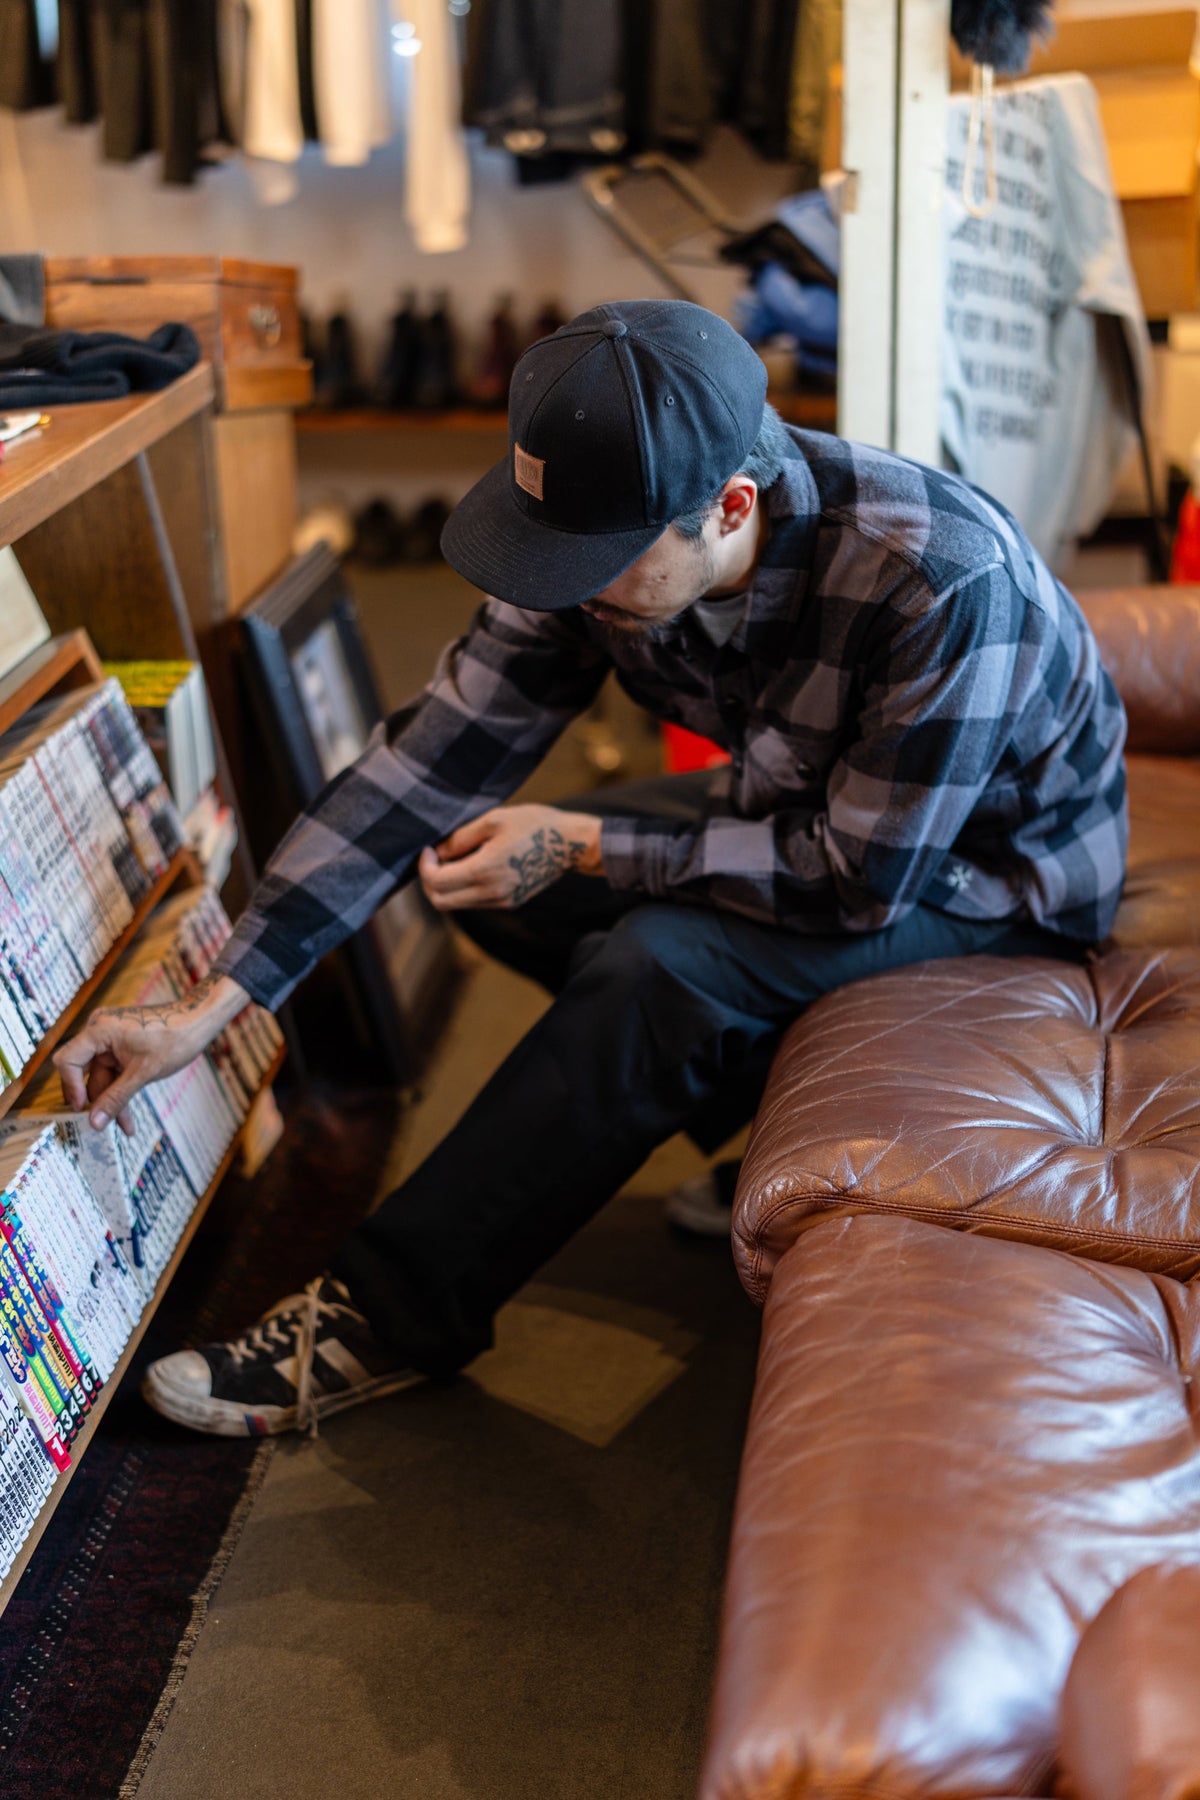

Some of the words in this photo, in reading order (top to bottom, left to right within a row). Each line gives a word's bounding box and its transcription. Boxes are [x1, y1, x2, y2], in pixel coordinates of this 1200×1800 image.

[84, 1360, 99, 1380] 7
[81, 1371, 93, 1392] 6
[73, 1382, 86, 1404] 5
[69, 1396, 80, 1416] 4
[60, 1408, 73, 1430] 3
[54, 1421, 67, 1442] 2
[51, 1436, 64, 1456] 1
